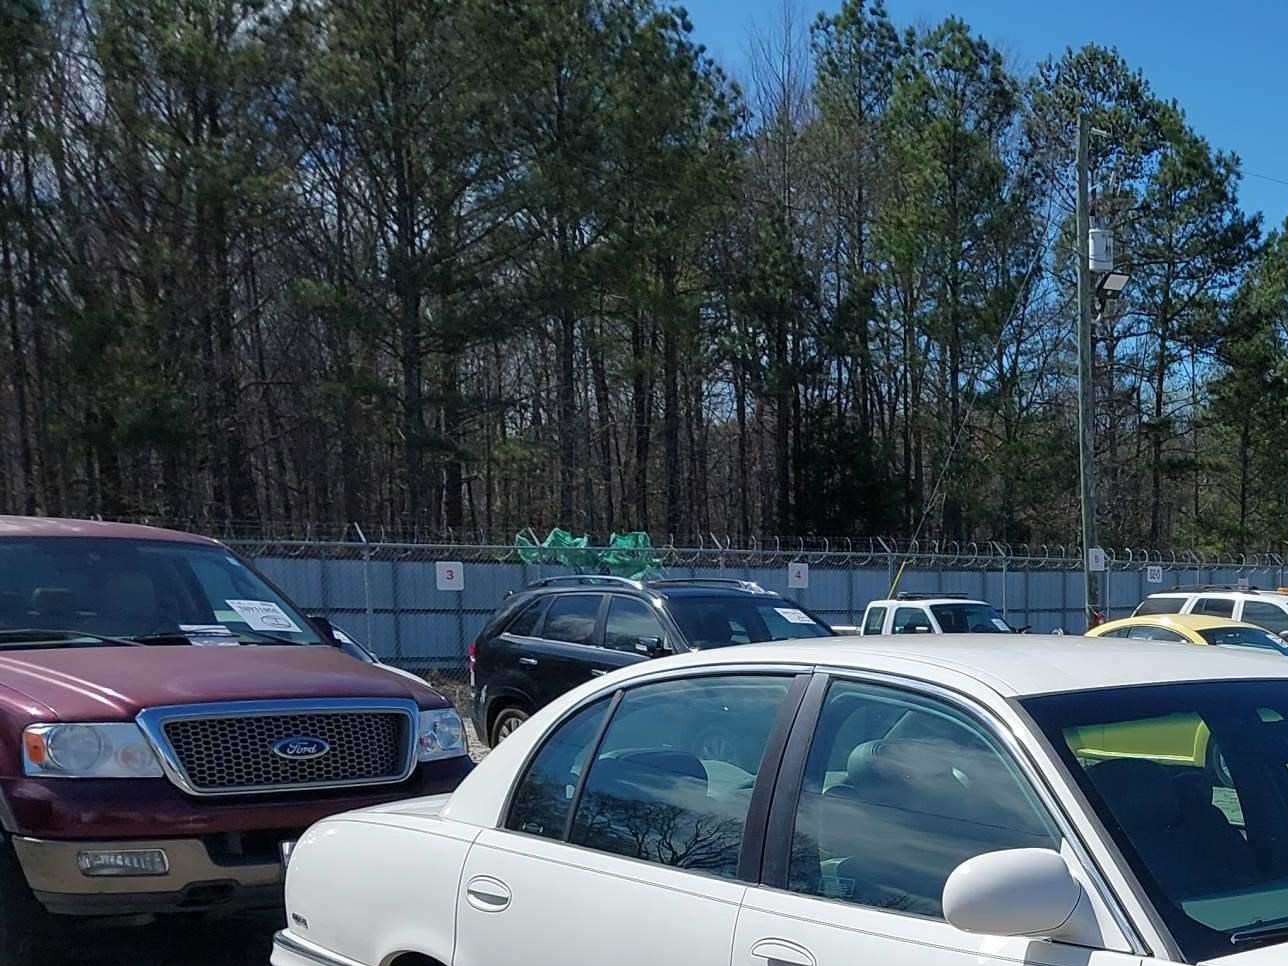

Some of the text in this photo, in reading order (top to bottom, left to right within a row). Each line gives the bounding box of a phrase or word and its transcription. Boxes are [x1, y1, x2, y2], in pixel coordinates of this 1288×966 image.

[446, 569, 455, 581] 3
[795, 570, 802, 580] 4
[286, 741, 318, 755] Ford
